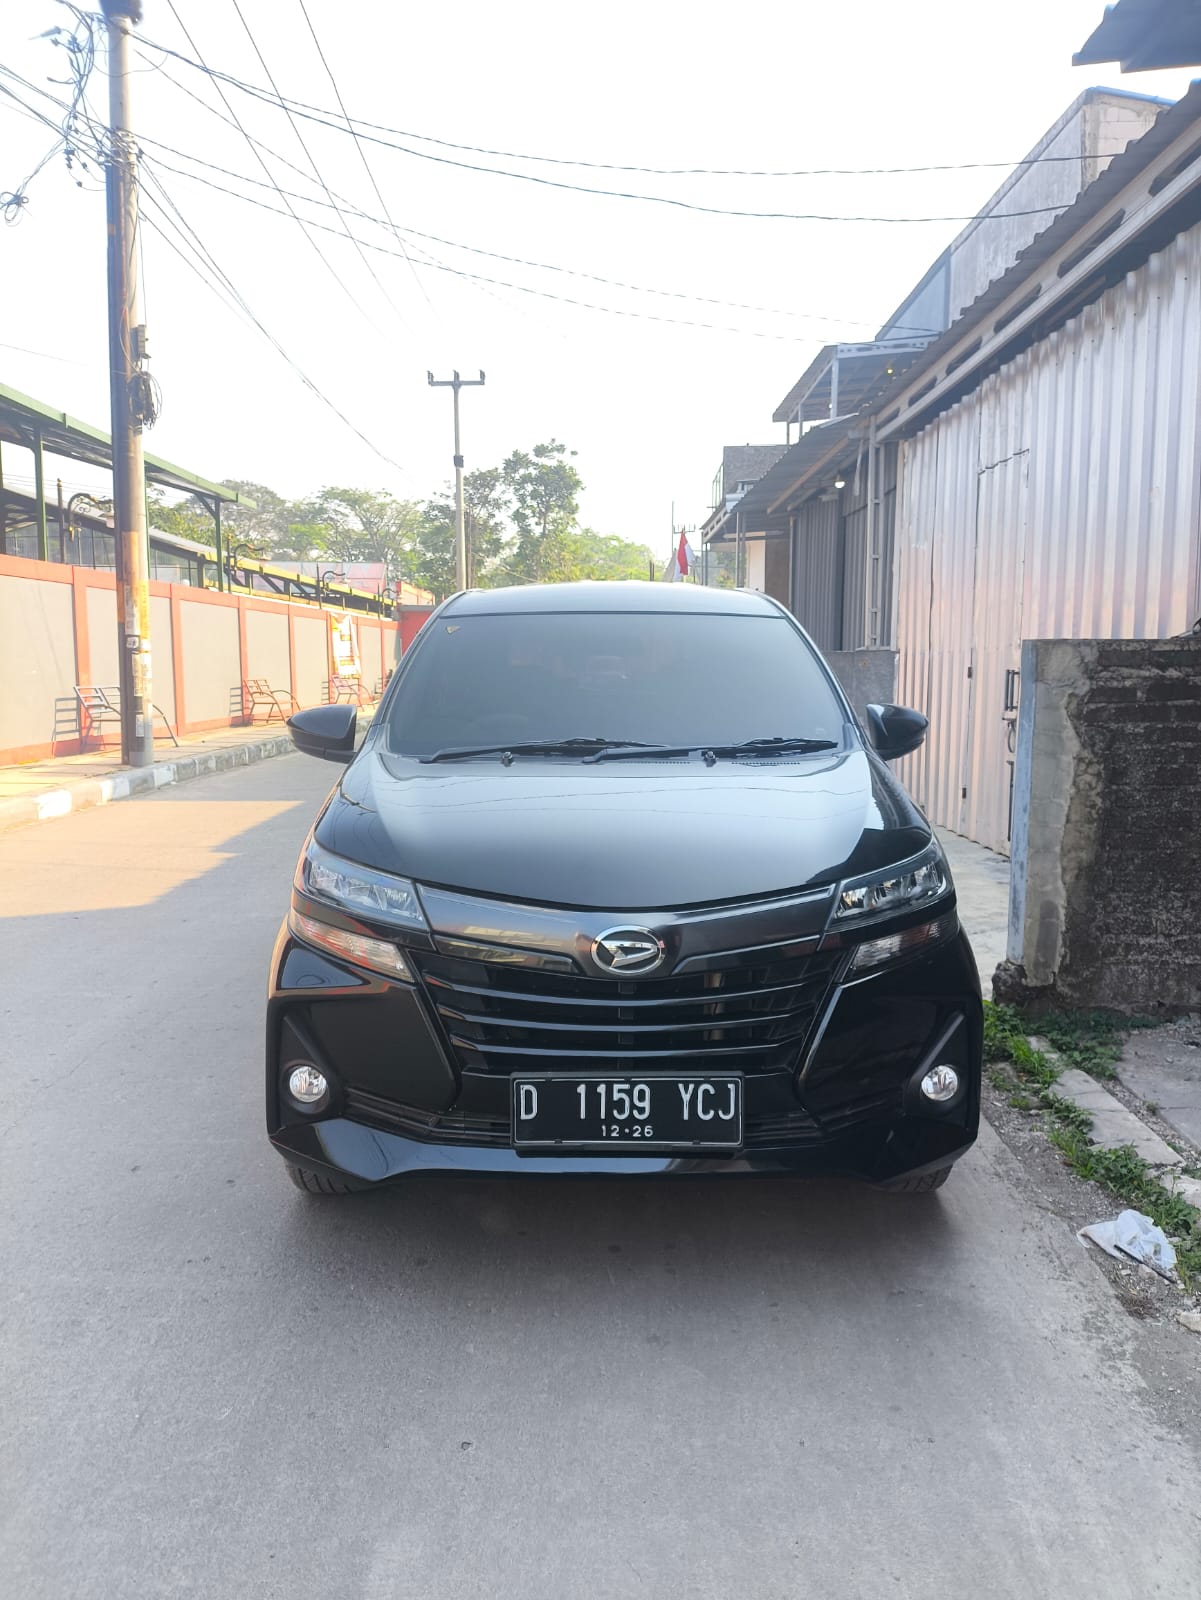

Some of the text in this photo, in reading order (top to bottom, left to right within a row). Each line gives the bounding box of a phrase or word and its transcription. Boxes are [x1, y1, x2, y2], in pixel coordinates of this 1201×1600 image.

[520, 1083, 735, 1120] D 1159 YCJ
